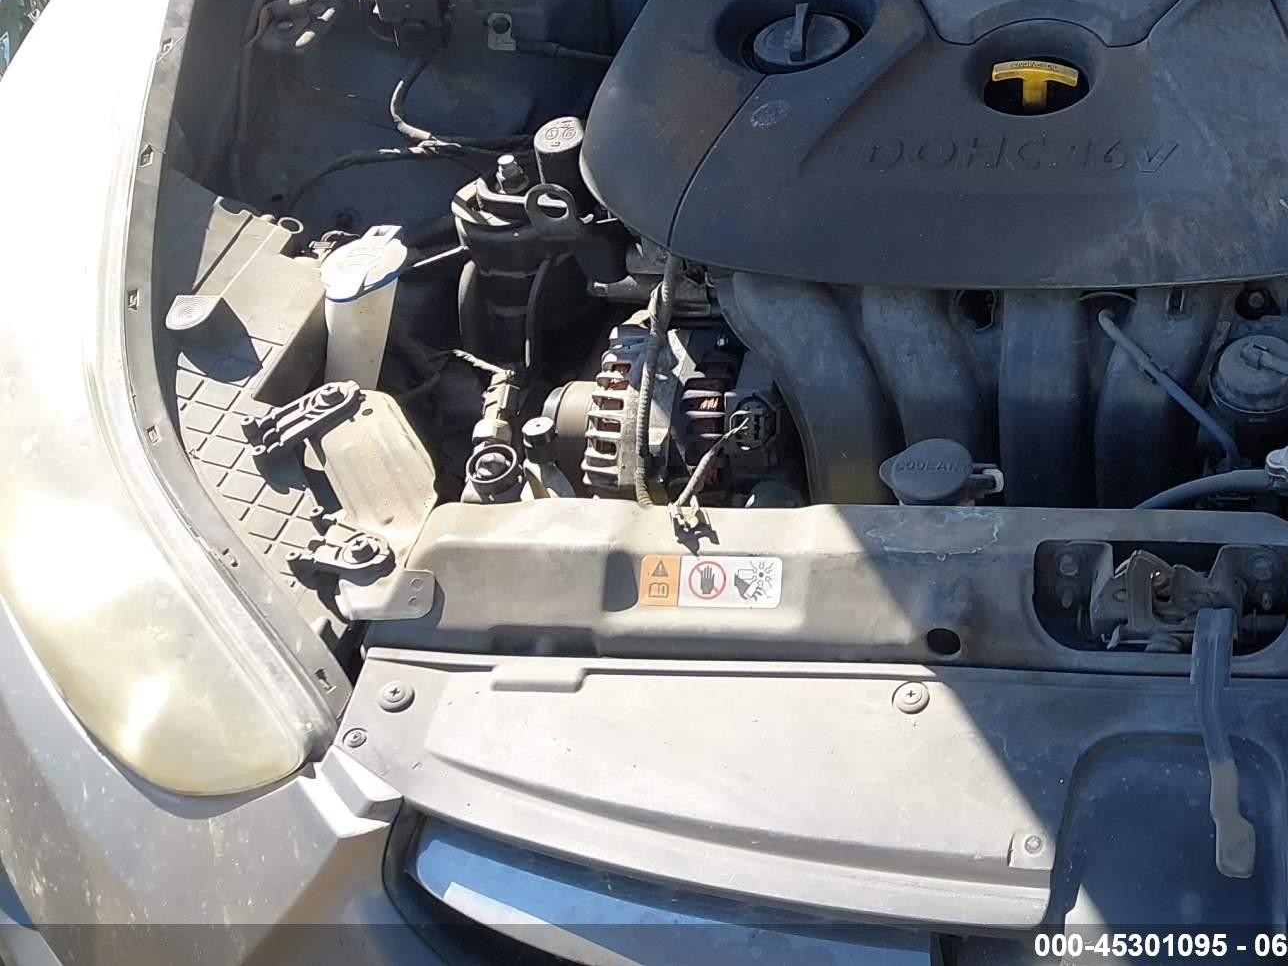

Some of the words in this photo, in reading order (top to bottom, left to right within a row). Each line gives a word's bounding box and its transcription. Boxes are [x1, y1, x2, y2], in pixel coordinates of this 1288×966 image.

[864, 136, 1043, 170] DOHC
[1069, 137, 1180, 173] 16V
[896, 459, 970, 475] COOLANT
